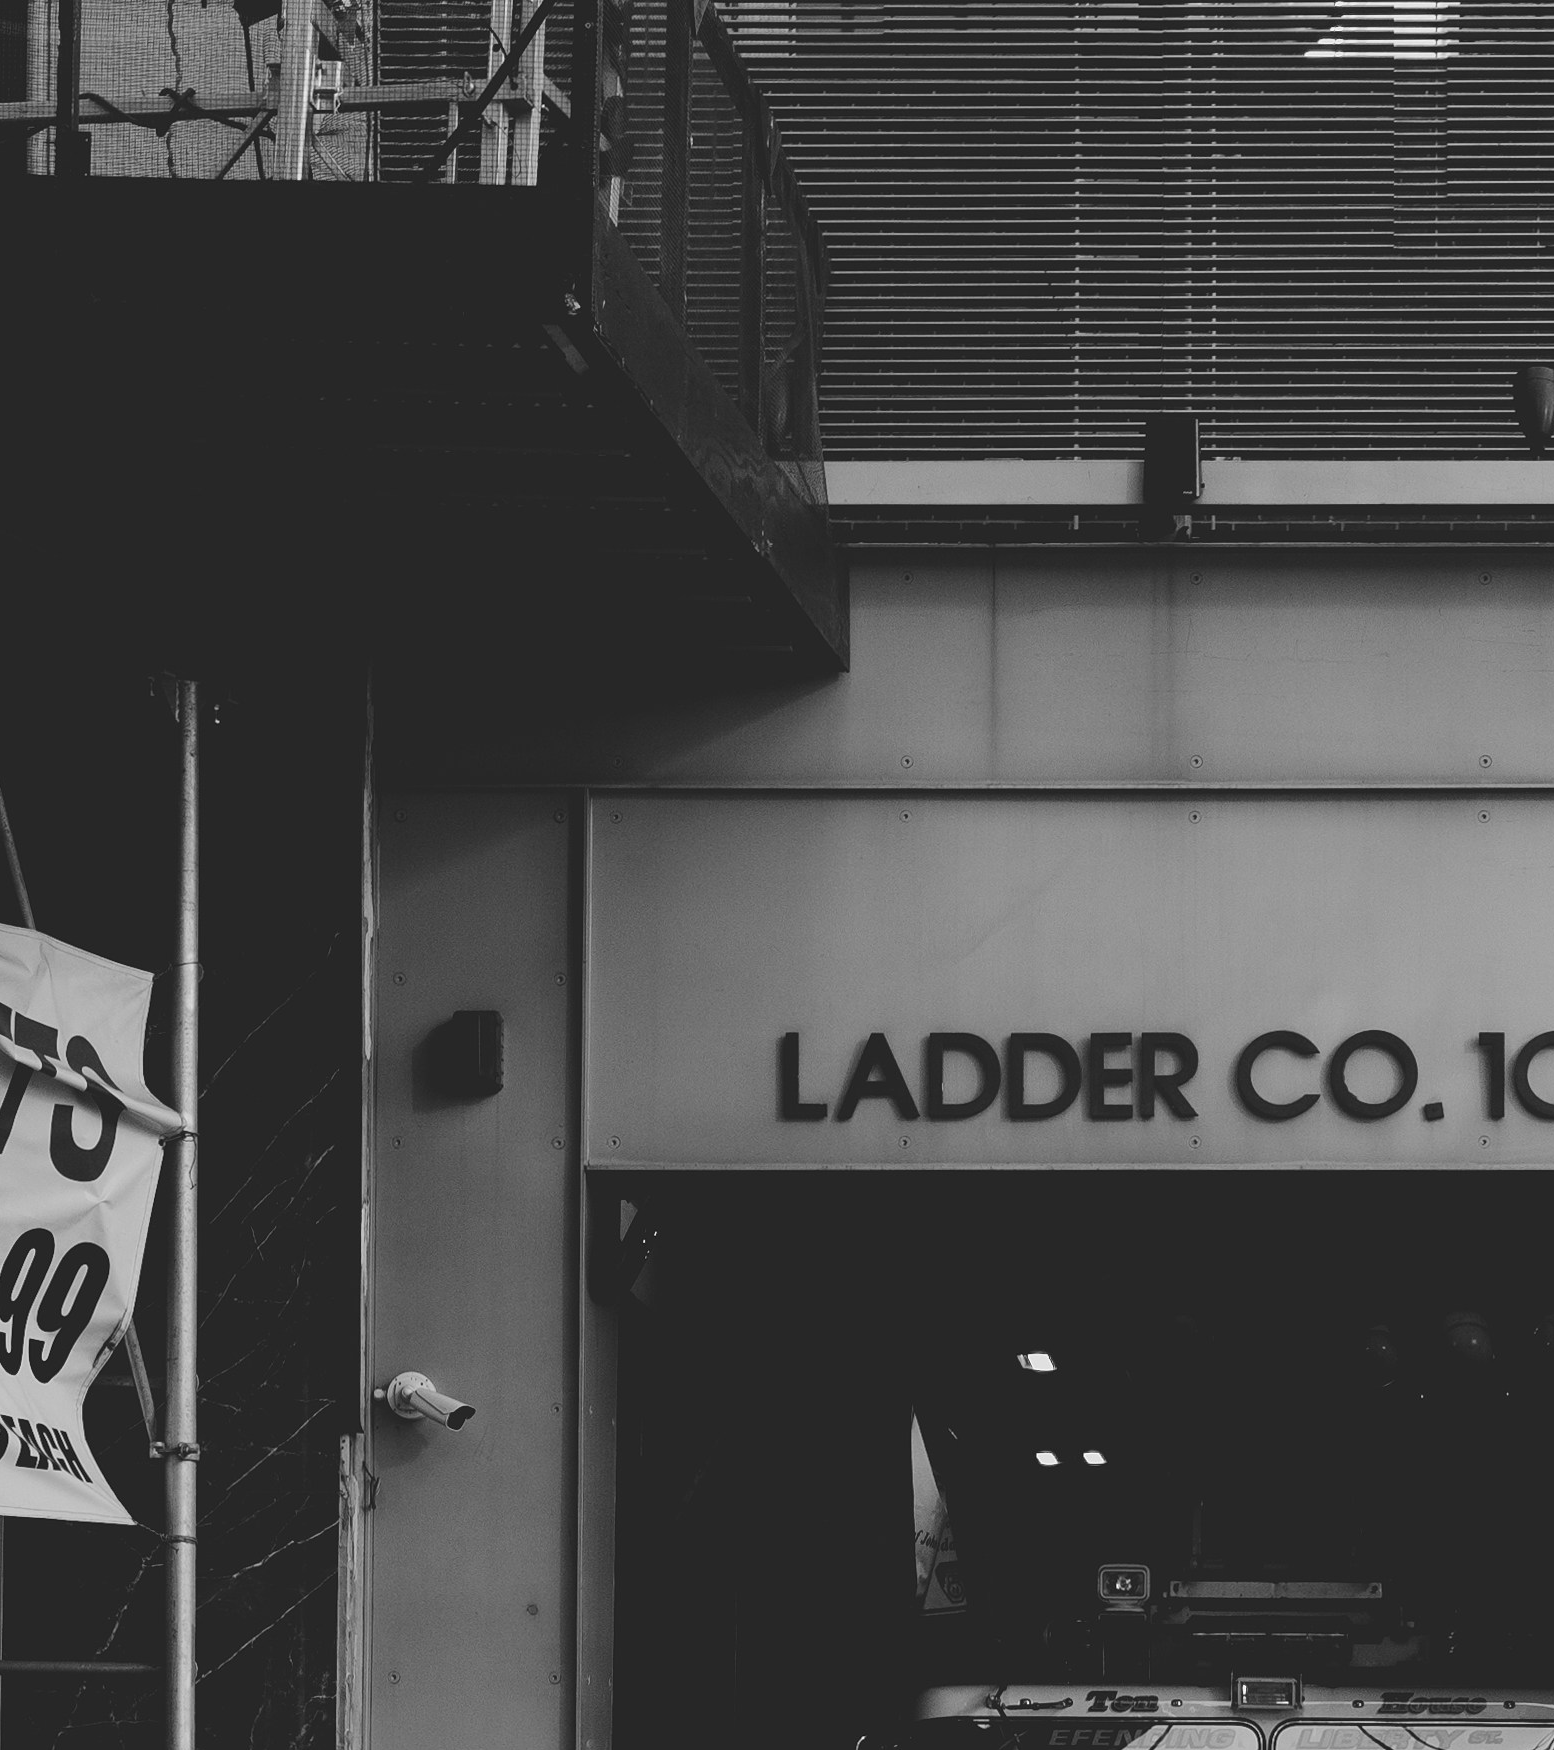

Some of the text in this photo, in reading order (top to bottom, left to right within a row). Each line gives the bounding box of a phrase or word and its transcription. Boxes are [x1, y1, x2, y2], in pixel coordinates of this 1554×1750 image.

[778, 1030, 1199, 1121] LADDER
[1239, 1029, 1445, 1121] CO.
[0, 1413, 94, 1484] EACH
[1085, 1690, 1159, 1713] Ten
[1375, 1692, 1488, 1716] House
[1296, 1729, 1504, 1750] LIBERTY ST.
